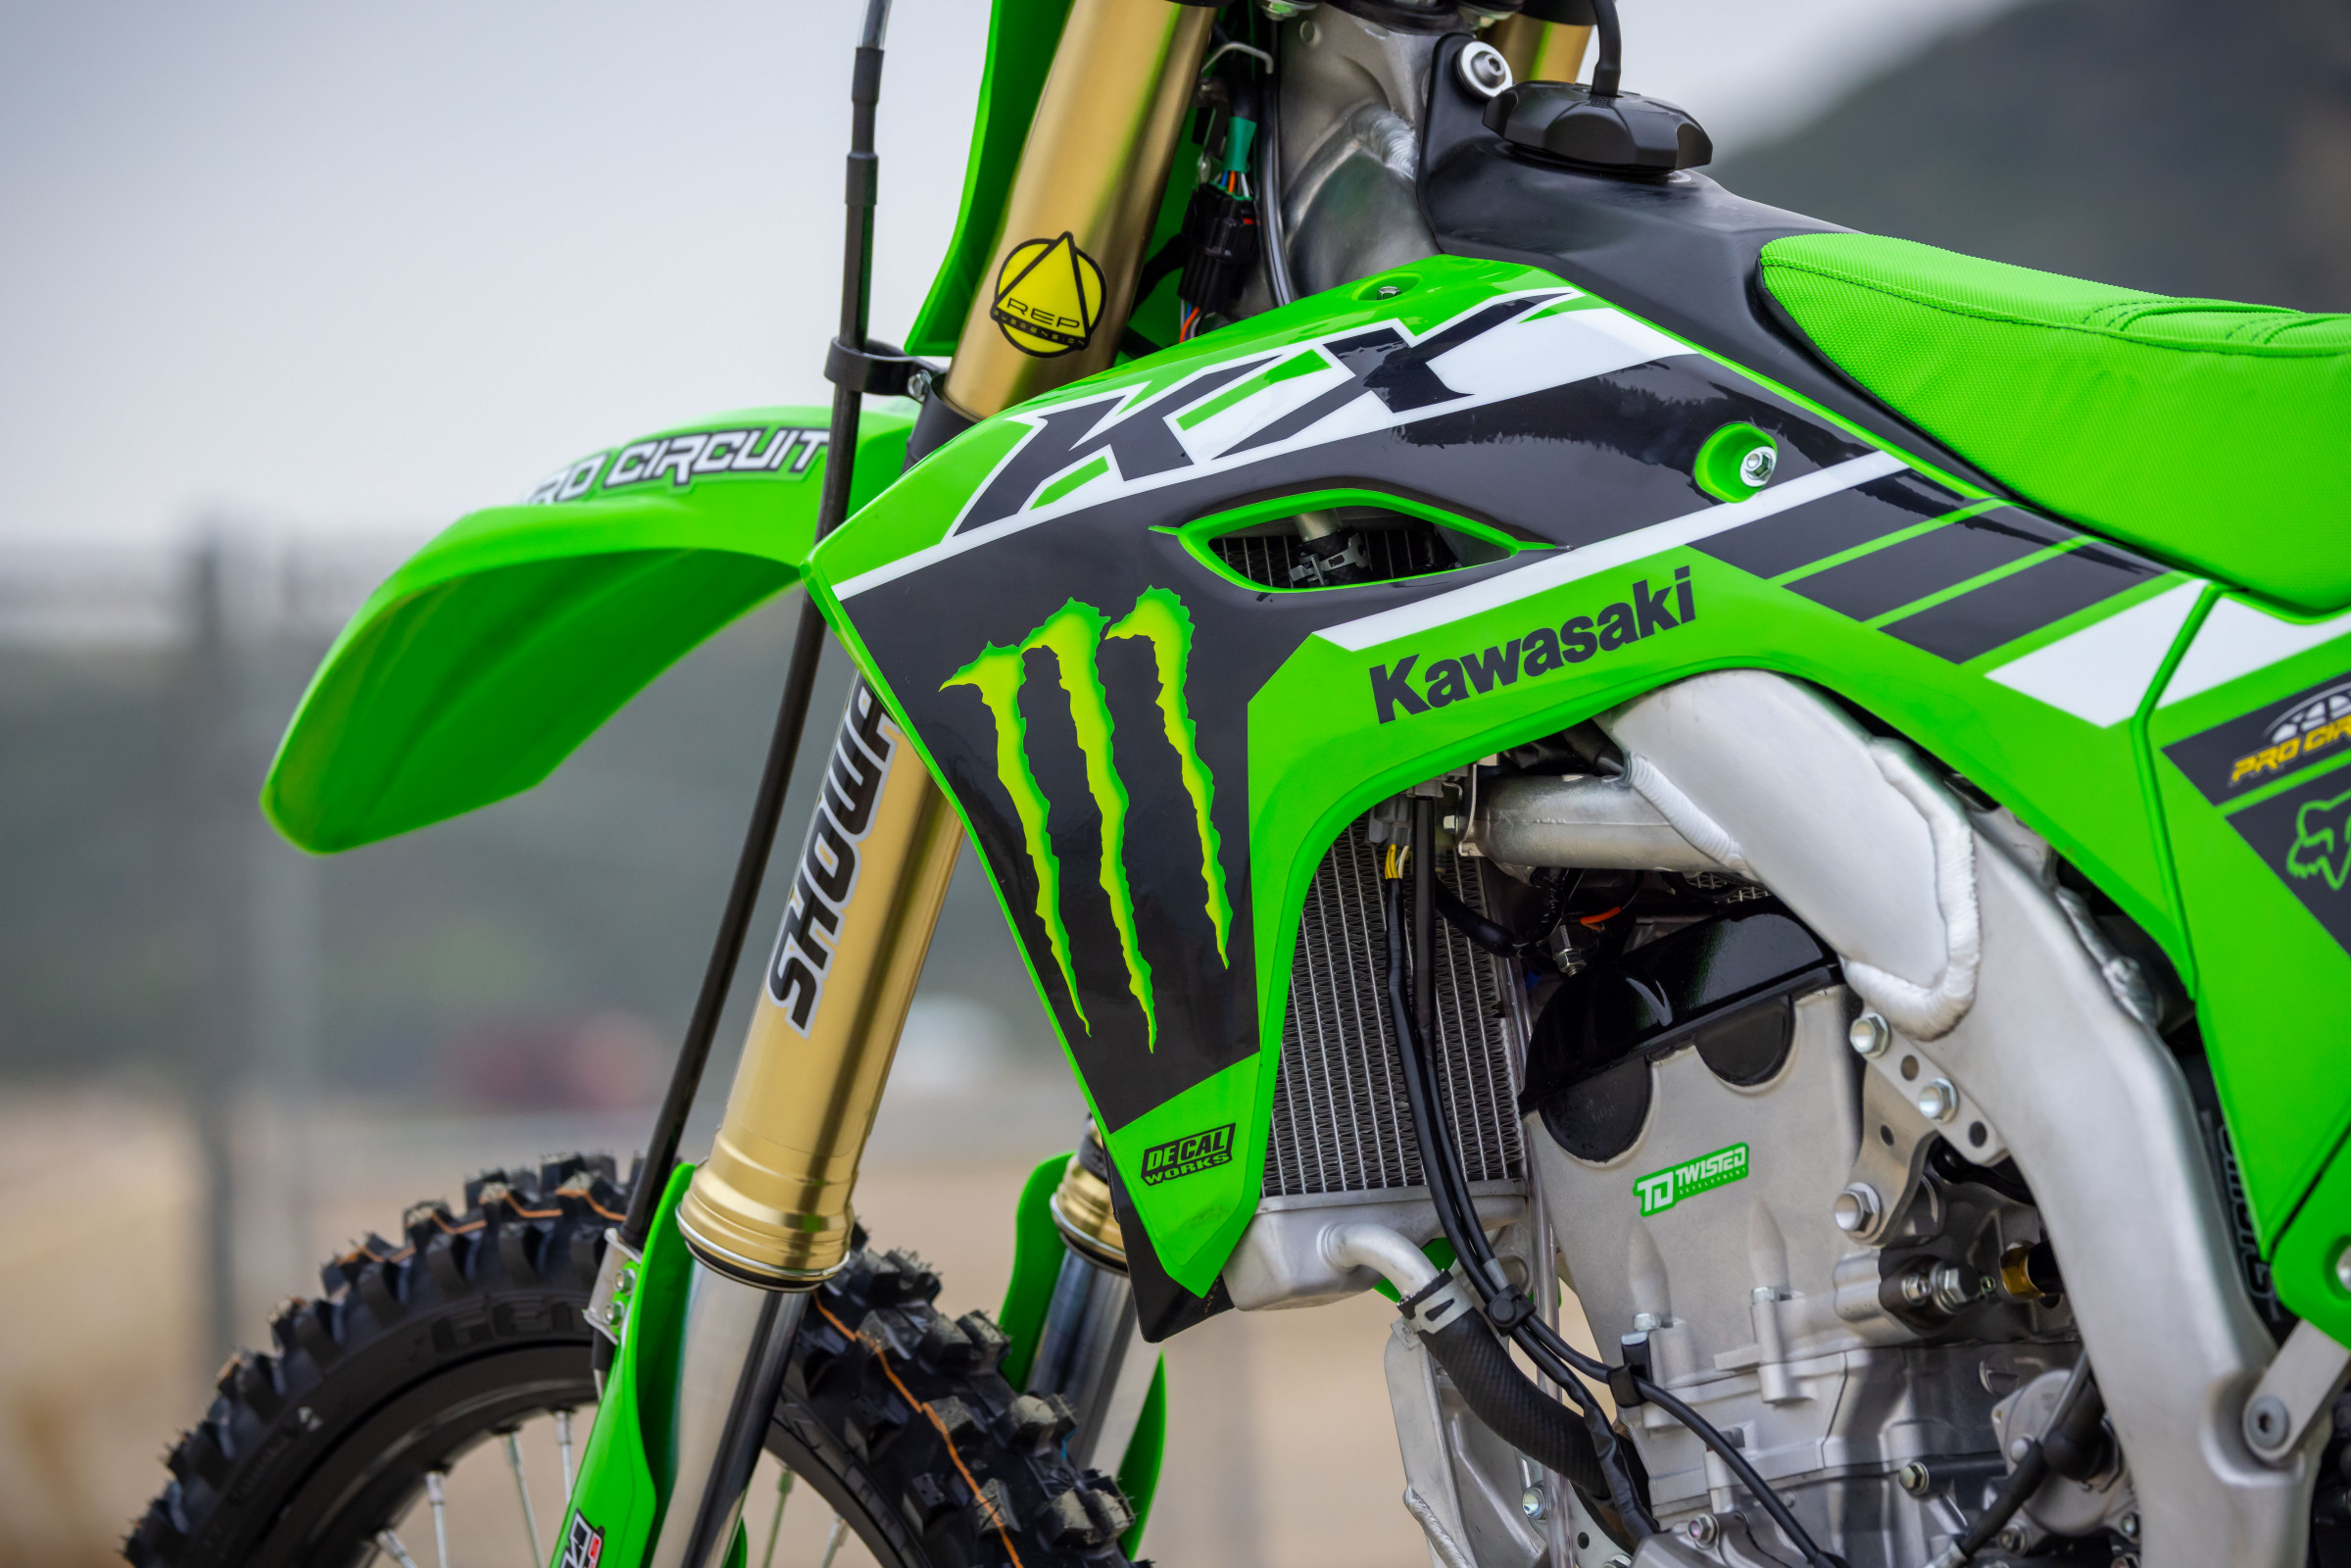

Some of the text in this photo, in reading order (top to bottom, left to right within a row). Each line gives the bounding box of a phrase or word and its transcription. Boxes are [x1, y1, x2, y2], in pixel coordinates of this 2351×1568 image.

[1006, 297, 1080, 329] REP
[949, 286, 1580, 538] KX
[603, 427, 832, 488] CIRCUIT
[1368, 564, 1696, 724] Kawasaki
[2229, 736, 2301, 783] PRO
[1145, 1152, 1230, 1185] WORKS
[1146, 1126, 1231, 1172] DECAL
[1676, 1147, 1745, 1188] TWISTED
